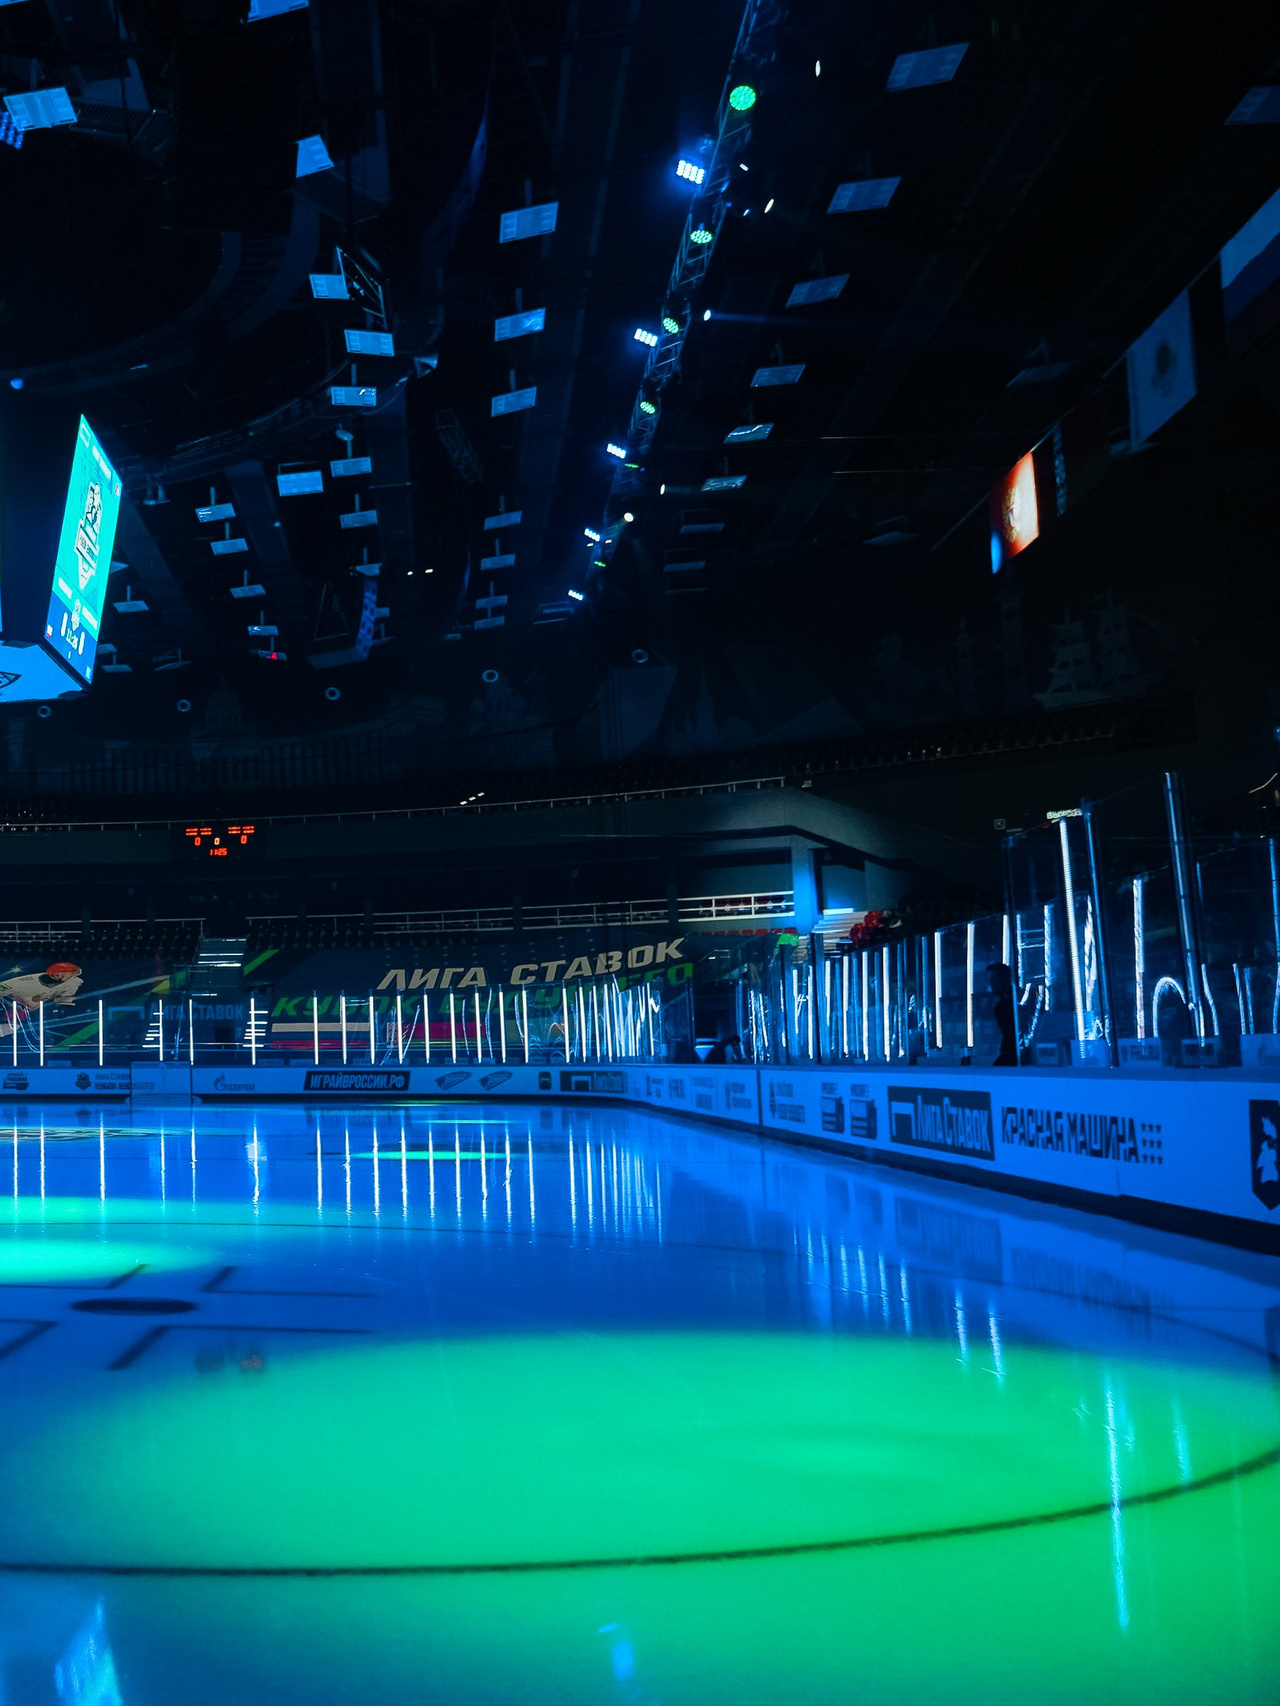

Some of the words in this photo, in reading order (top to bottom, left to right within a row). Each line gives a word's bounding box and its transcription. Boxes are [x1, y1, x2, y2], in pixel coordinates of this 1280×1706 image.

[194, 837, 201, 846] 0
[214, 837, 220, 845] 0
[240, 835, 247, 844] 0
[377, 966, 487, 990] ЛИГА
[510, 937, 685, 985] СТАВОК
[191, 1001, 244, 1020] СТАВОК
[310, 1072, 405, 1089] ИГРАЙВРОССИИ.РФ
[1001, 1106, 1064, 1153] КРАСНАЯ
[1067, 1112, 1140, 1164] МАШИНА
